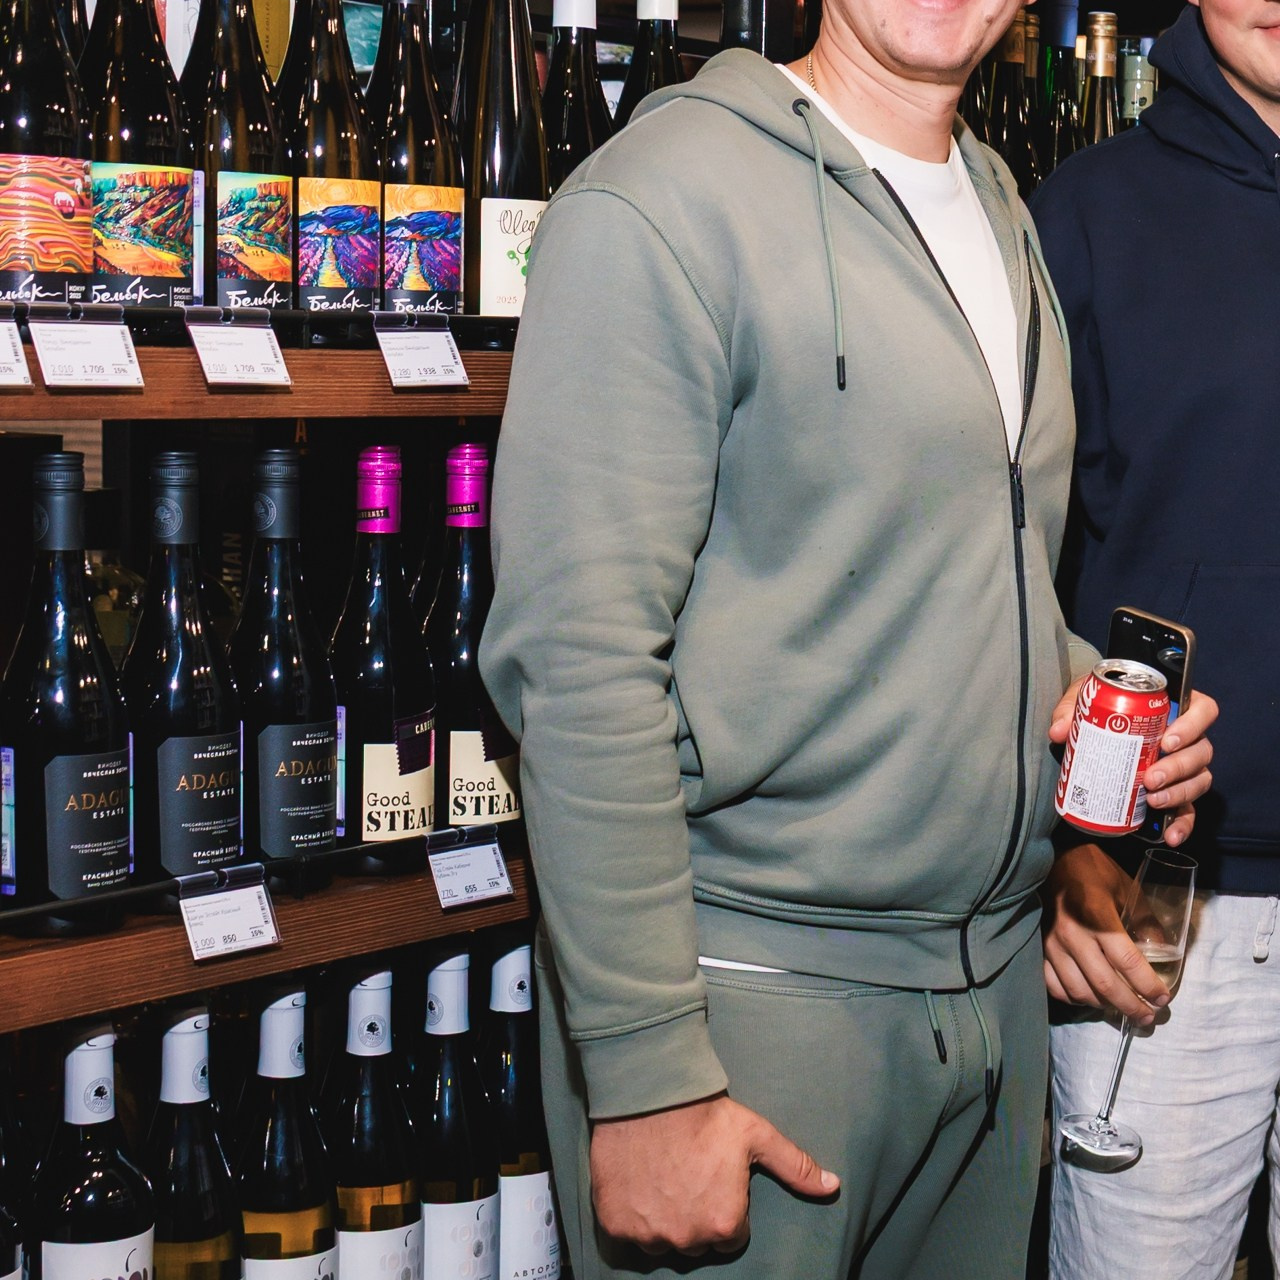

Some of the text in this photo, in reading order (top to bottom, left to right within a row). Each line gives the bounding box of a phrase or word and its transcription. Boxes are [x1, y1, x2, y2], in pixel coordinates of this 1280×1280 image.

[92, 276, 167, 304] Бельбек
[226, 282, 289, 309] Бельбек
[307, 289, 371, 313] Бельбек
[392, 292, 454, 313] Бельбек
[89, 365, 105, 373] 709
[240, 364, 255, 372] 709
[423, 367, 437, 375] 938
[301, 774, 331, 785] ESTATE
[453, 777, 497, 792] Good
[203, 787, 235, 799] ESTATE
[366, 791, 412, 807] Good
[92, 807, 124, 820] ESTATE
[290, 831, 321, 842] КРАСНЫЙ
[193, 847, 224, 858] КРАСНЫЙ
[82, 869, 115, 881] КРАСНЫЙ
[441, 879, 500, 898] 770 655 15%
[222, 933, 237, 944] 850
[250, 929, 264, 938] 15%
